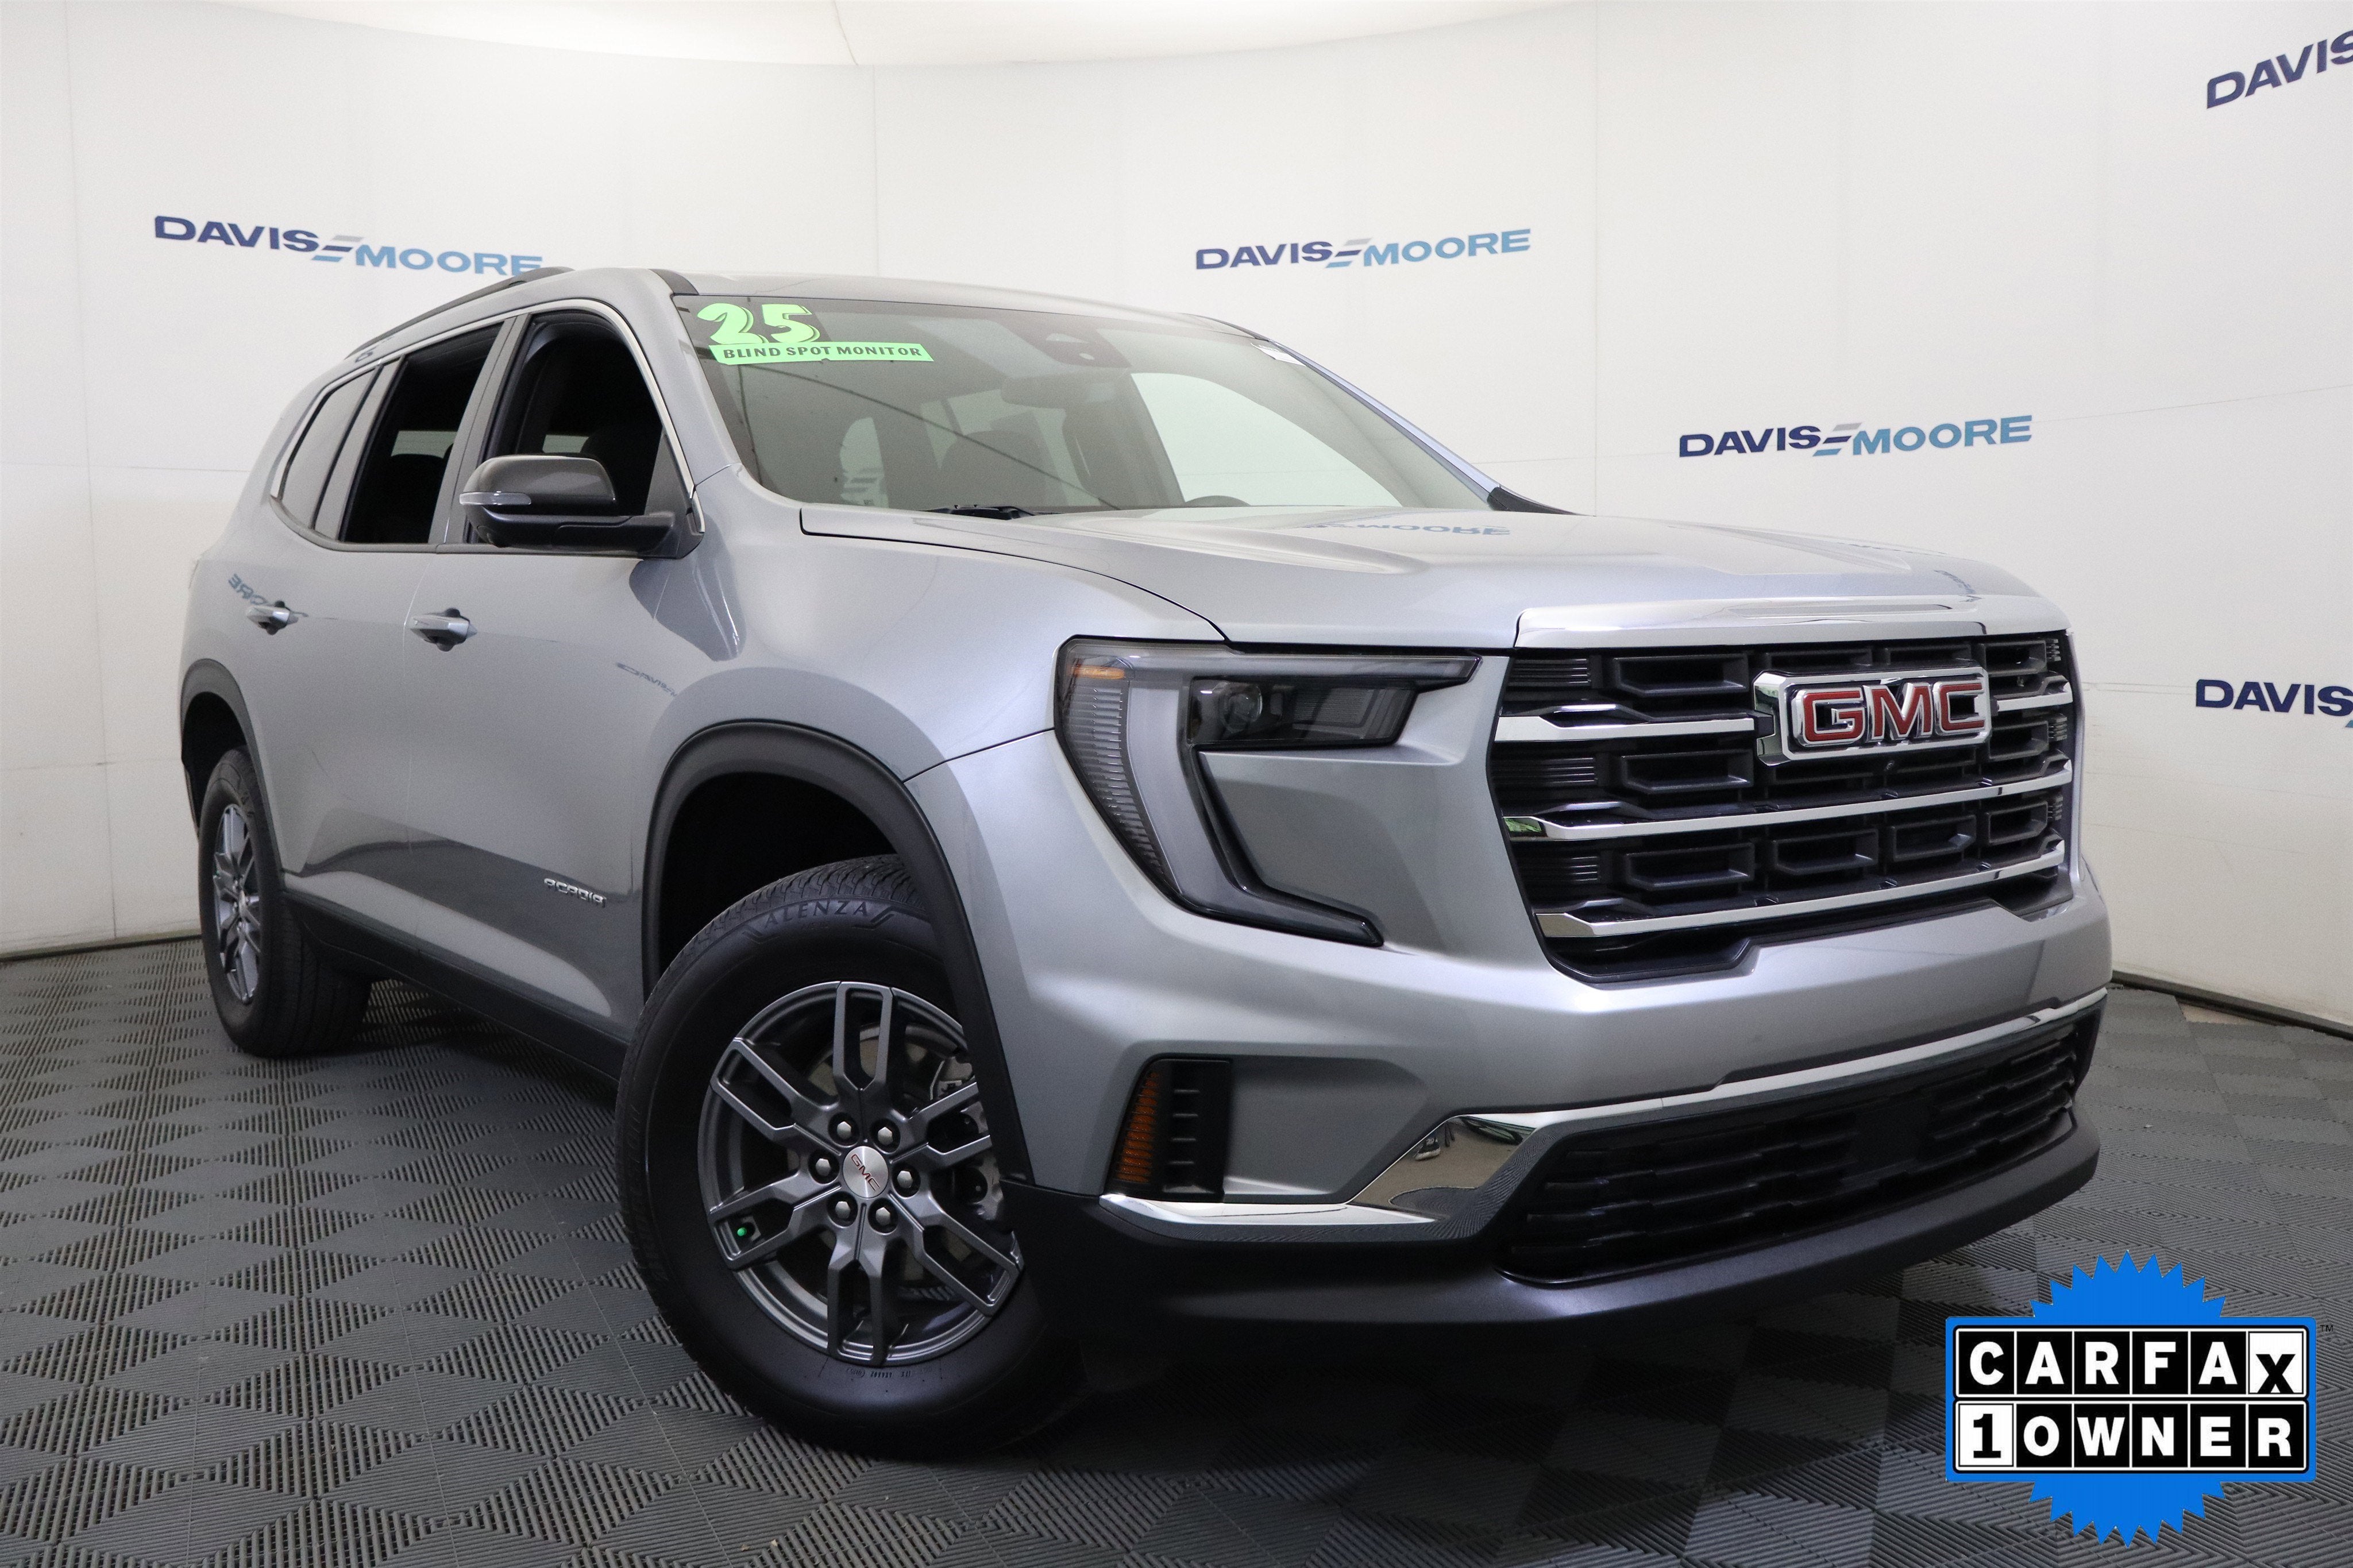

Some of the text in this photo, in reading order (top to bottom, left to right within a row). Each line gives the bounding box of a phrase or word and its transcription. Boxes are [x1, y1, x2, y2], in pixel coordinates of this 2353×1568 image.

[2207, 30, 2353, 108] DAVIS
[155, 215, 543, 277] DAVIS MOORE
[1196, 228, 1532, 270] DAVIS MOORE
[697, 302, 820, 344] 25
[723, 346, 922, 359] BLIND SPOT MONITOR
[1679, 414, 2034, 458] DAVIS MOORE
[1793, 682, 1986, 745] GMC
[2196, 679, 2353, 717] DAVIS
[763, 899, 869, 928] ALENZA
[851, 1154, 881, 1192] GMC
